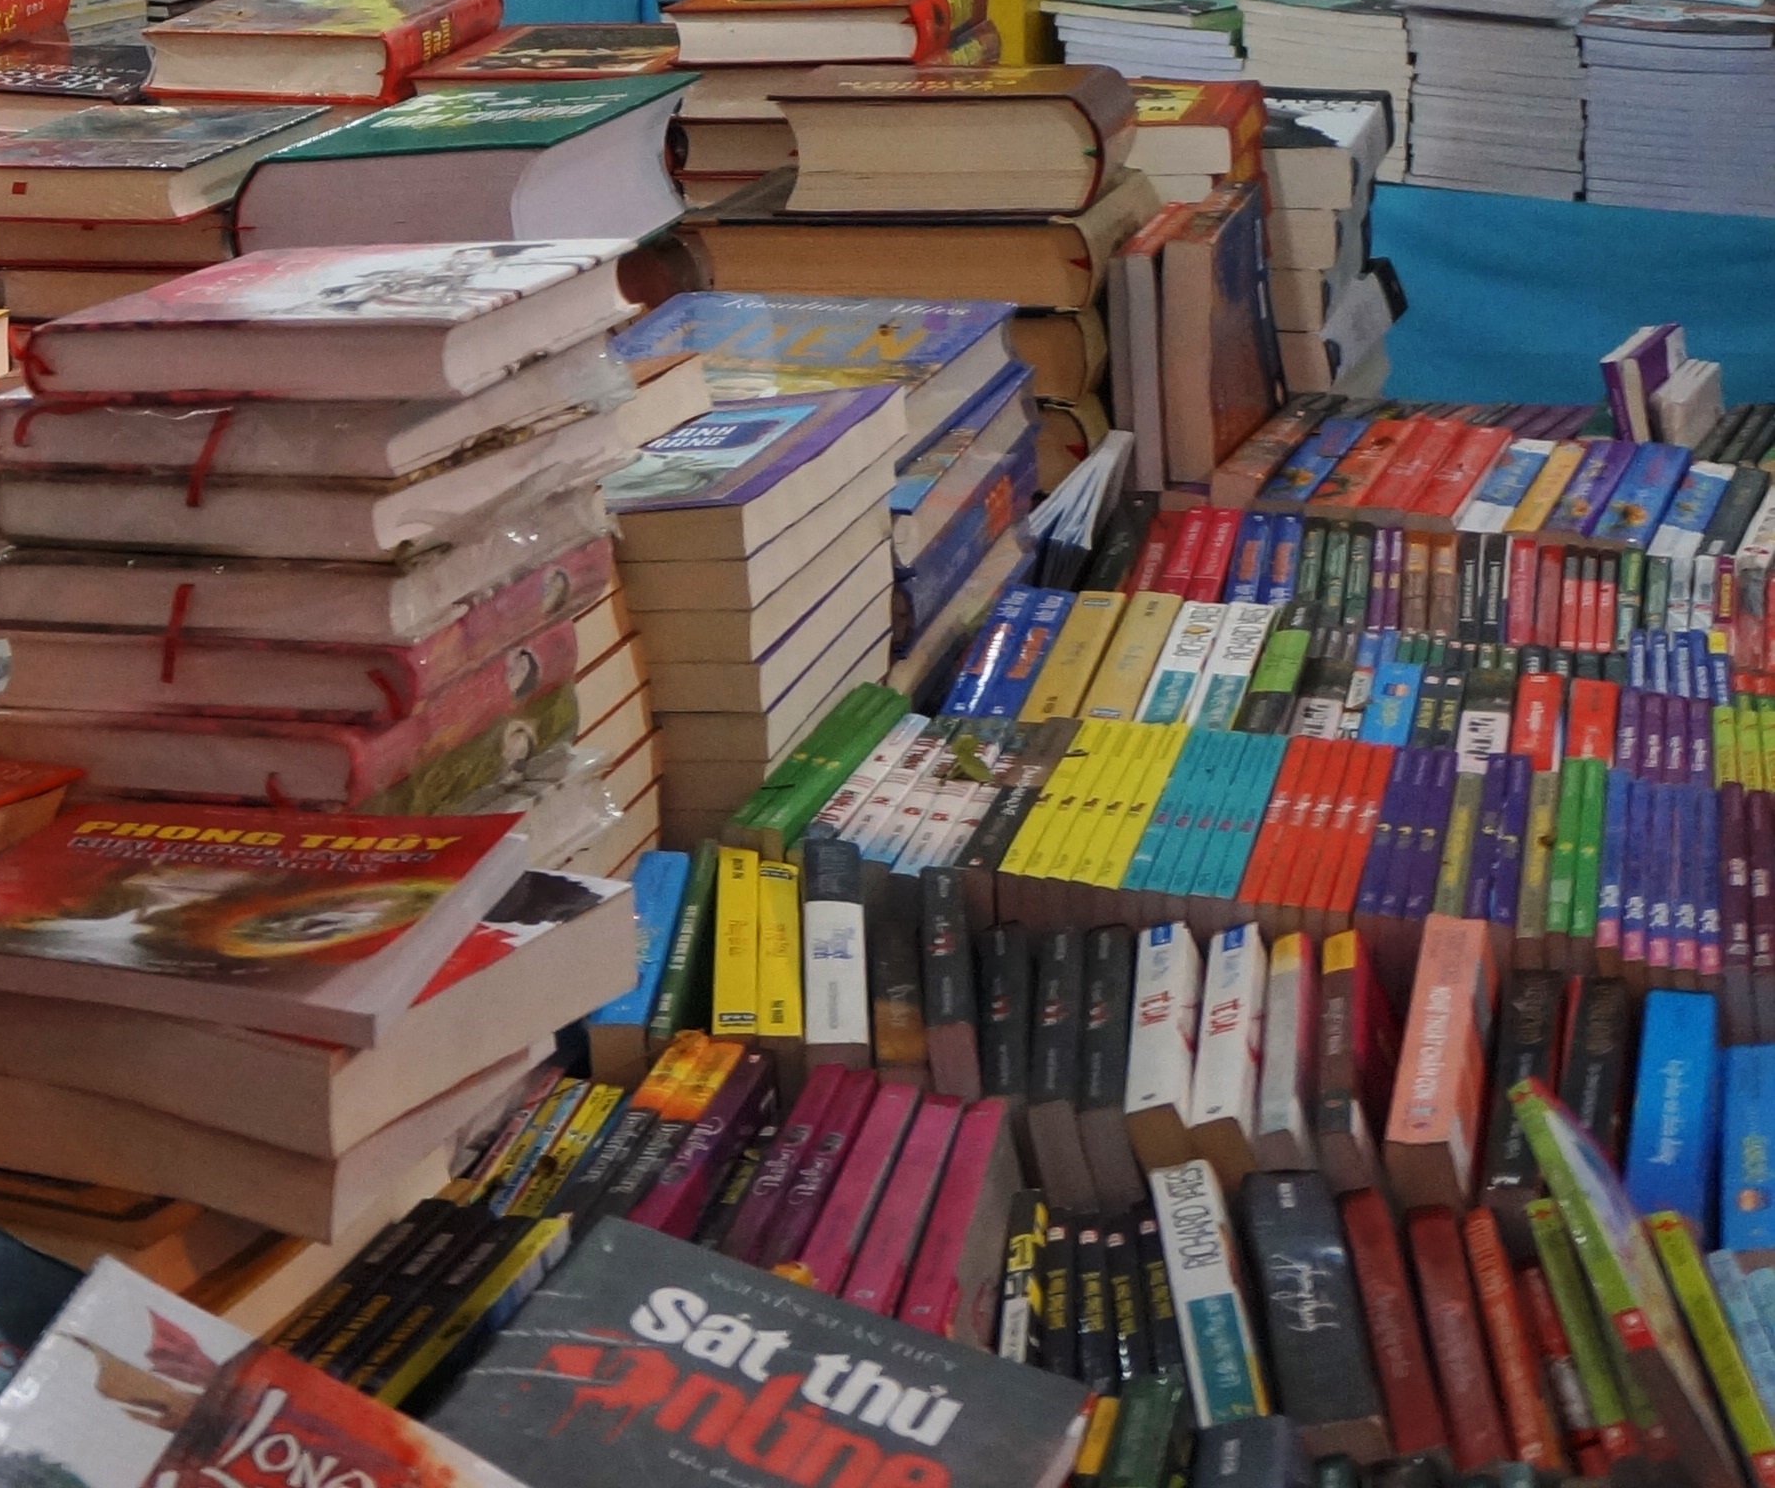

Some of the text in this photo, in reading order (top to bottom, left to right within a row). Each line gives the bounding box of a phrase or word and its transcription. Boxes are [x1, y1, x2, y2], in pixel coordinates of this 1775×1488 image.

[73, 820, 289, 848] PHONG
[630, 1286, 792, 1382] Sát
[803, 1350, 966, 1448] thủ
